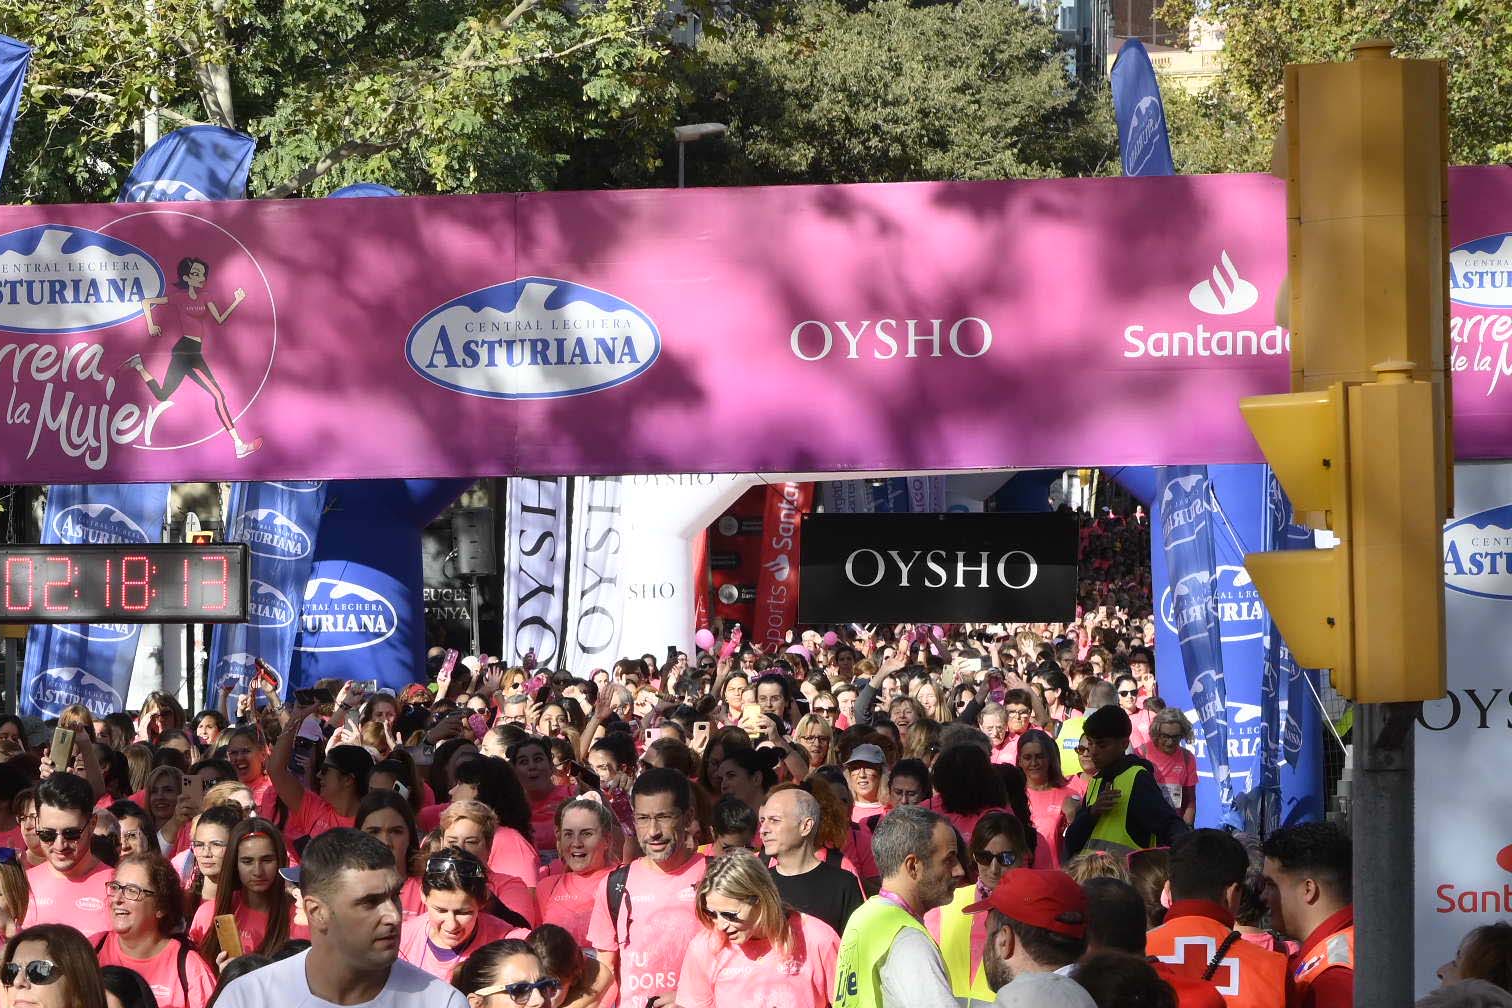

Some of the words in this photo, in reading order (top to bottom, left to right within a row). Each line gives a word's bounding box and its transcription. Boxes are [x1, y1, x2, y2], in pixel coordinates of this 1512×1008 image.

[68, 261, 140, 272] LECHERA
[1464, 259, 1512, 267] CENTRA
[465, 321, 543, 333] CENTRAL
[552, 319, 632, 331] LECHERA
[790, 317, 993, 361] OYSHO
[1450, 314, 1512, 343] arre
[426, 324, 640, 369] ASTURIANA
[1472, 344, 1492, 371] la
[6, 387, 31, 424] la
[26, 377, 174, 471] Mujer
[240, 529, 302, 555] STURIANA
[1471, 537, 1512, 546] CENT
[516, 474, 559, 669] OYSH
[577, 474, 622, 655] OYSH
[845, 548, 1039, 590] OYSHO
[1436, 884, 1512, 914] Sant
[630, 973, 677, 989] DORS
